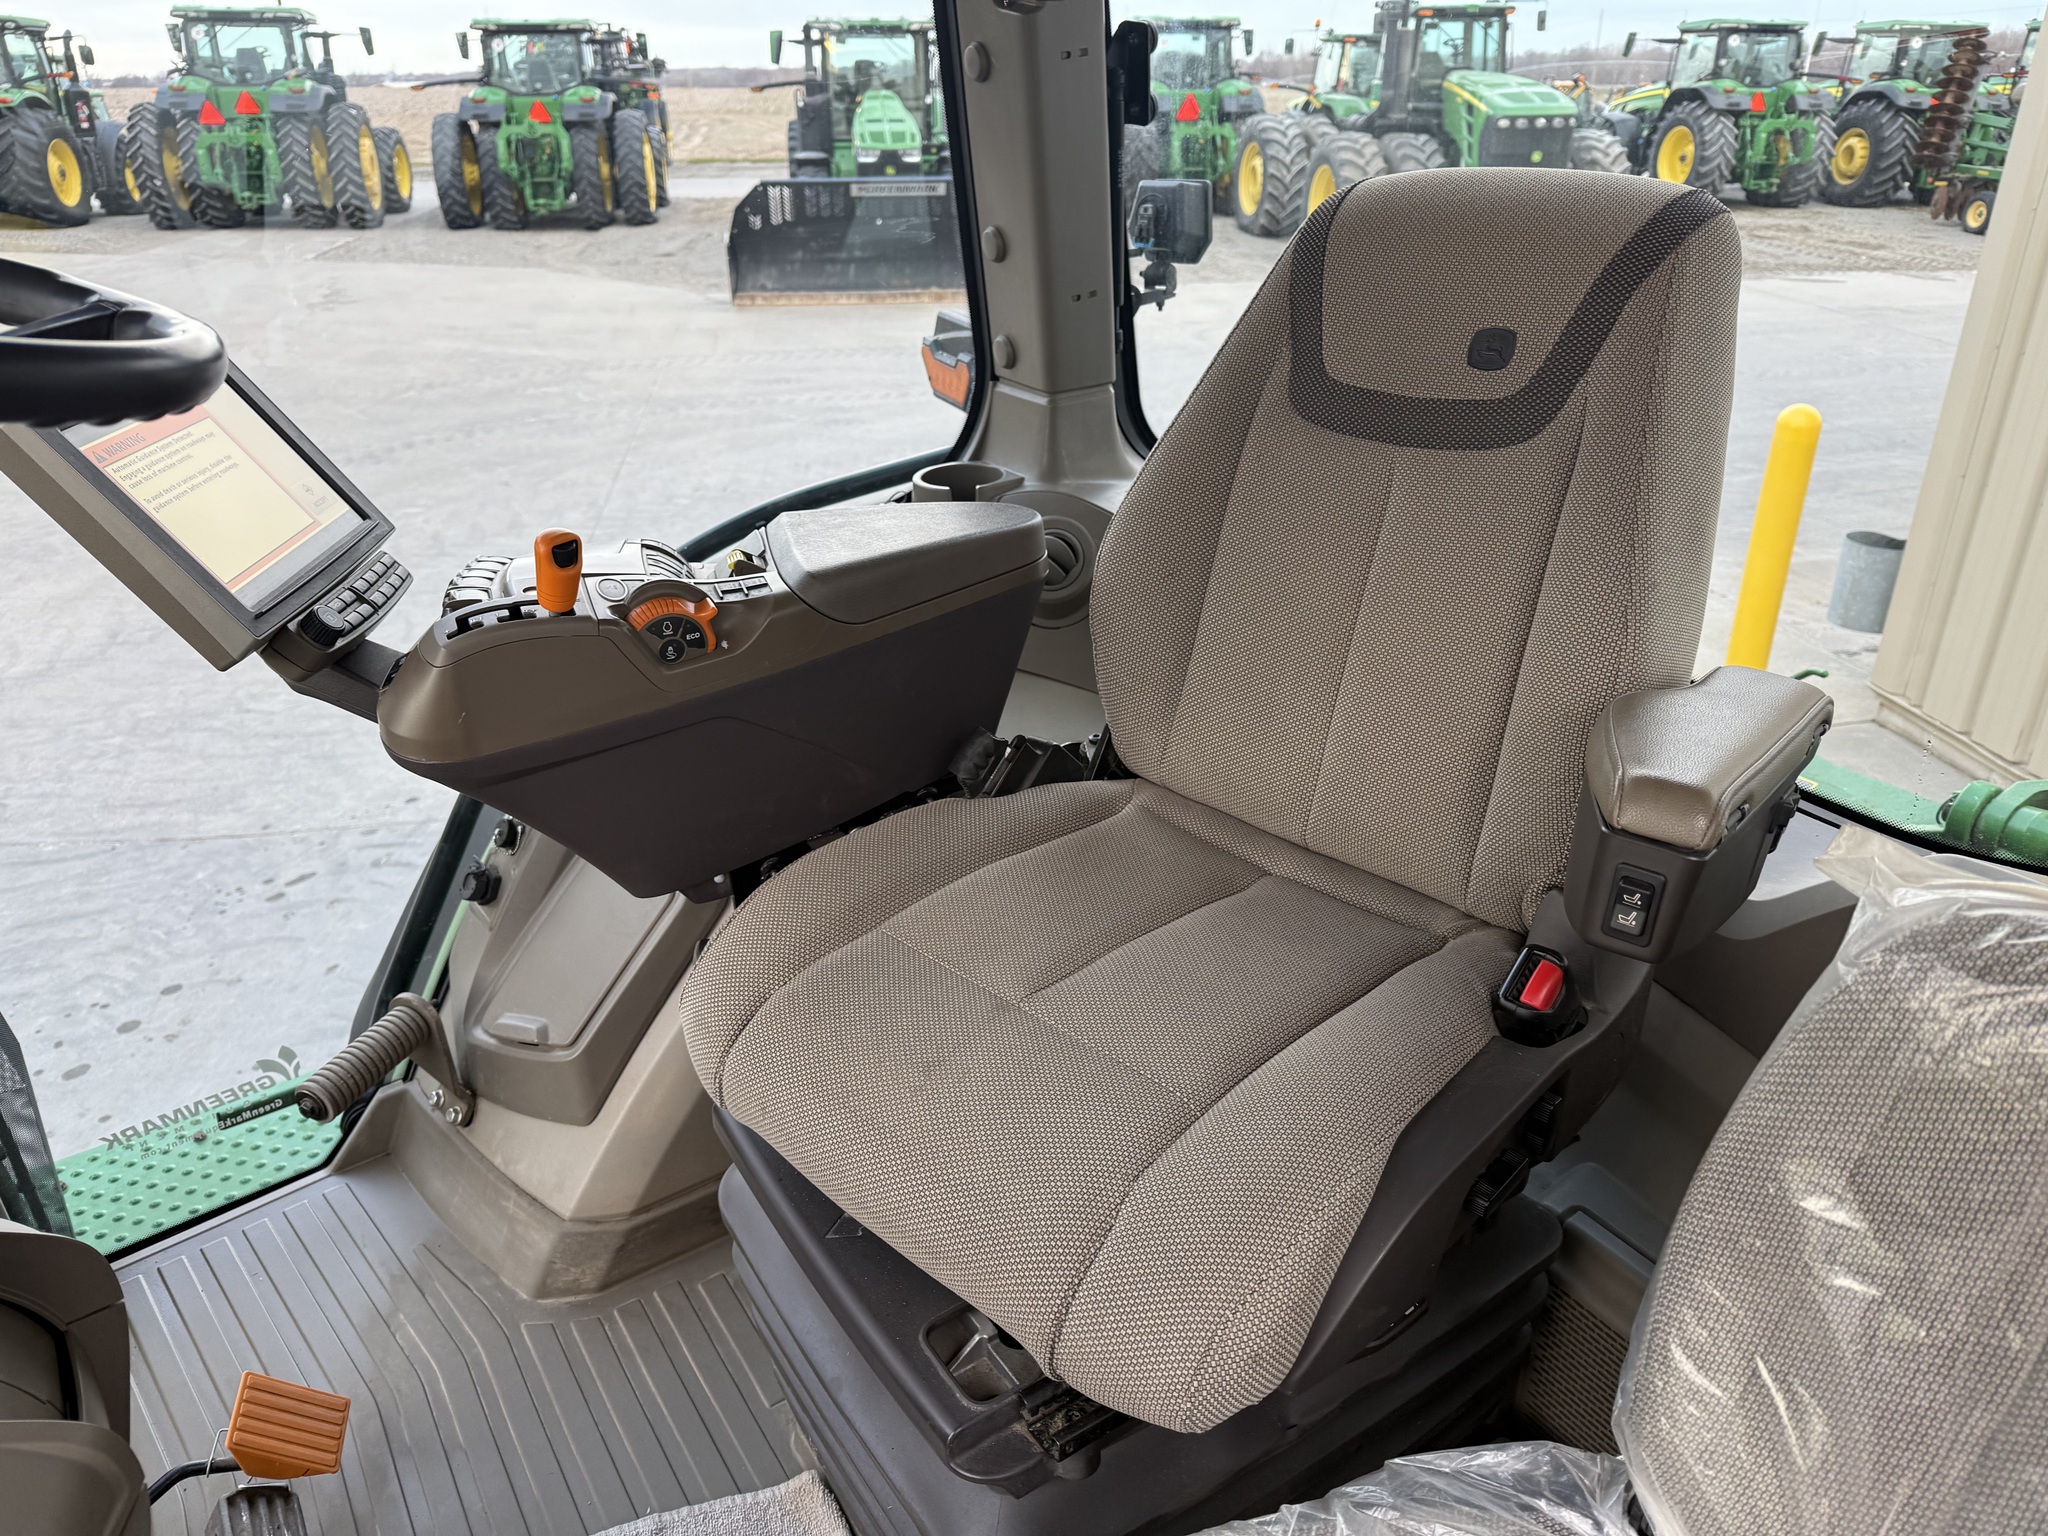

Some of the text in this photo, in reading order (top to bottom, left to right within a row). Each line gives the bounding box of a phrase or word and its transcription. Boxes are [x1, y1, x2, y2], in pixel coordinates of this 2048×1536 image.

[102, 433, 146, 457] WARNING
[112, 458, 138, 474] Automatic
[136, 448, 158, 461] Guidance
[156, 441, 174, 452] System
[119, 467, 143, 482] Engaging
[145, 457, 166, 470] guidance
[165, 448, 181, 460] system
[186, 436, 206, 448] roadways
[129, 478, 143, 489] cause
[141, 474, 153, 483] loss
[157, 462, 177, 474] machine
[151, 490, 164, 501] avoid
[163, 484, 177, 495] death
[181, 473, 199, 485] serious
[153, 498, 174, 513] guidance
[173, 489, 190, 501] system
[187, 482, 203, 492] before
[202, 472, 222, 484] entering
[686, 632, 700, 640] ECO
